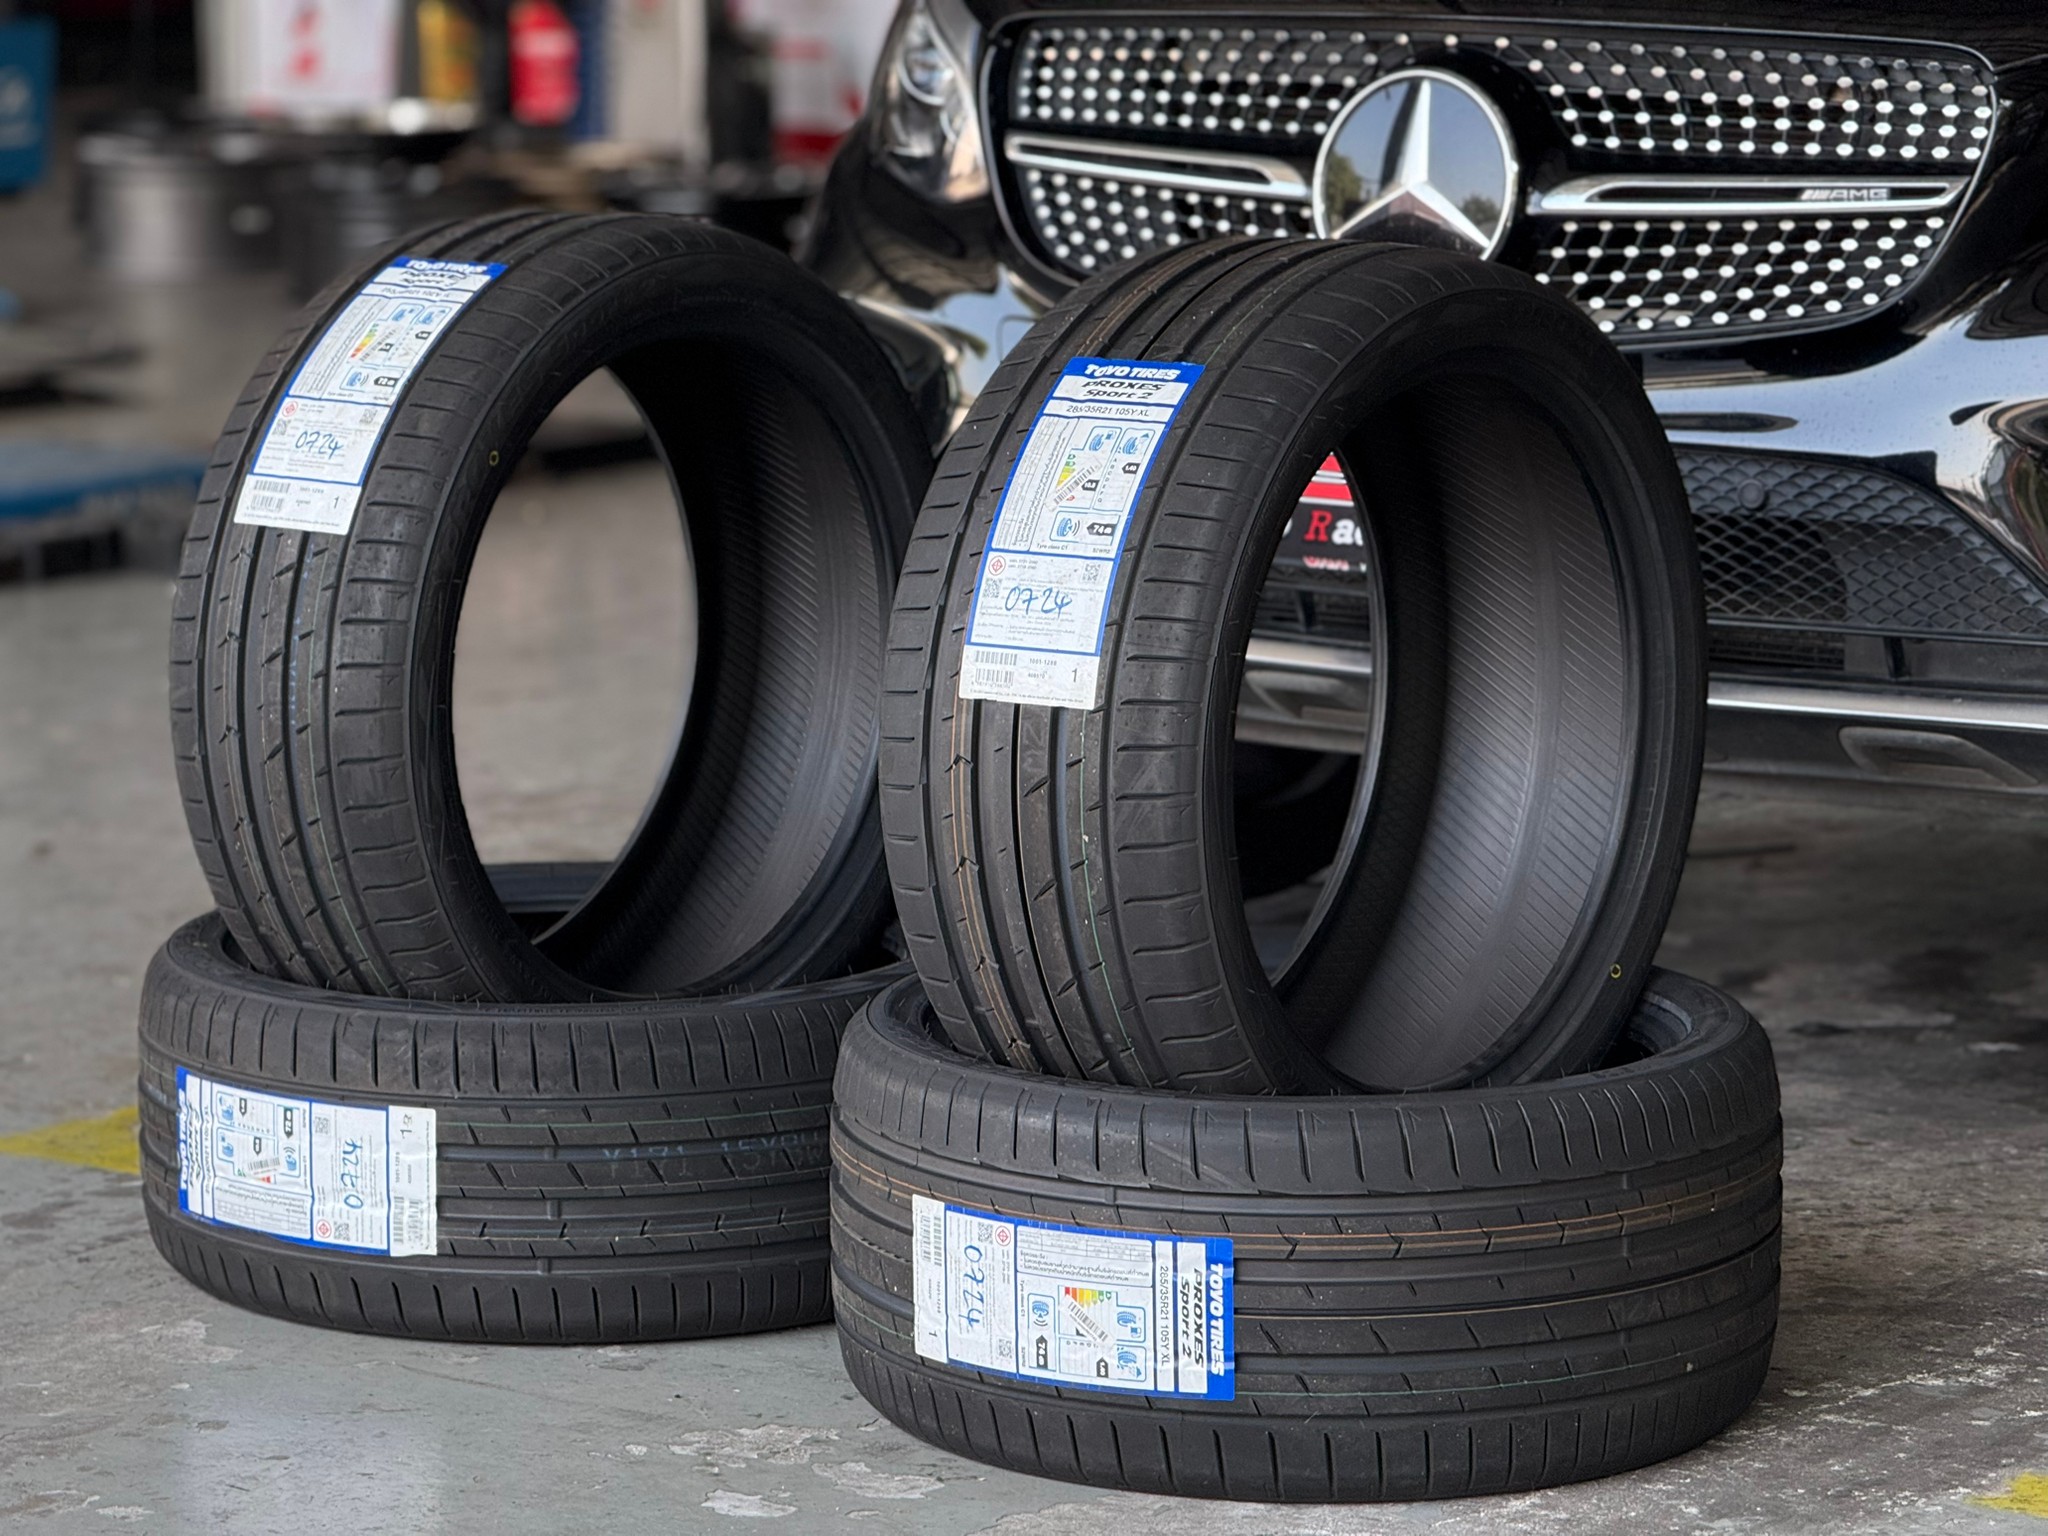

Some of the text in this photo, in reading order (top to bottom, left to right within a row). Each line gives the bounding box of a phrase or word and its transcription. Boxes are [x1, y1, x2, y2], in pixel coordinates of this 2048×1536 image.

[1829, 188, 1888, 201] AMG
[1129, 367, 1181, 380] TIRES
[1066, 405, 1112, 414] 285/35R21
[1115, 408, 1137, 416] 105Y
[295, 430, 343, 460] 0724
[1093, 525, 1104, 533] 74
[1005, 586, 1072, 618] 0724
[1072, 668, 1078, 683] 1
[341, 1139, 363, 1209] 0724
[958, 1244, 985, 1328] 0724
[1159, 1265, 1170, 1367] 285/35R21 105Y XL
[1193, 1267, 1205, 1369] PROXES
[1209, 1262, 1225, 1377] TOYO TIRES
[1037, 1341, 1046, 1354] 74
[1182, 1343, 1192, 1361] 2
